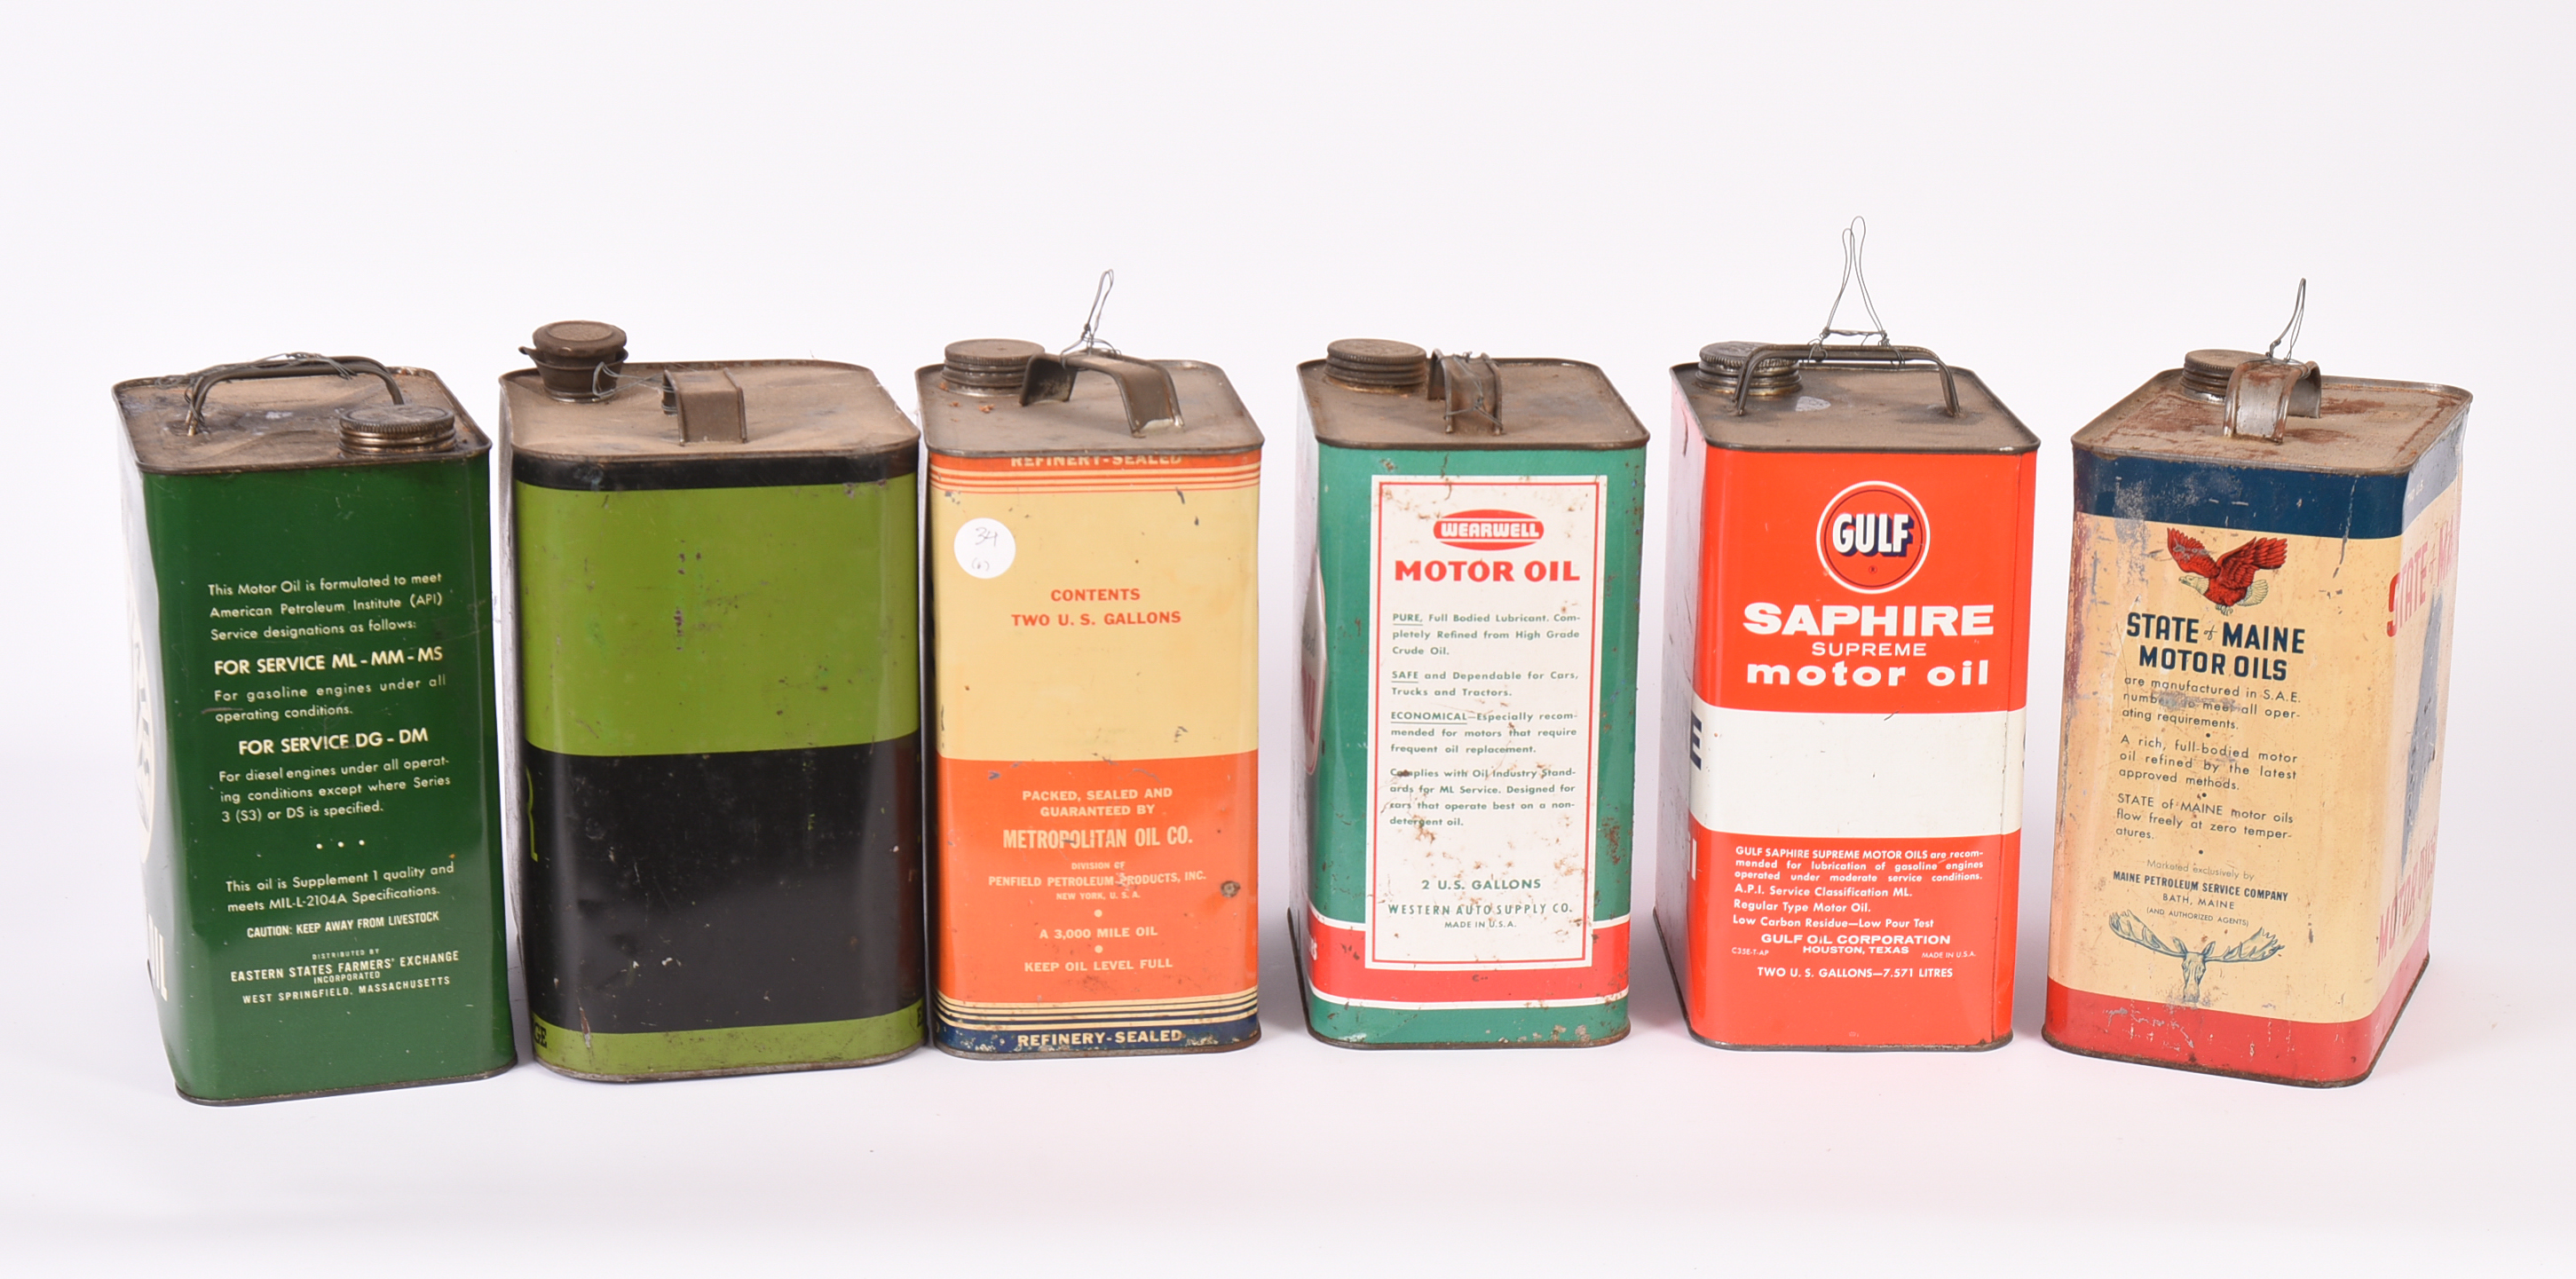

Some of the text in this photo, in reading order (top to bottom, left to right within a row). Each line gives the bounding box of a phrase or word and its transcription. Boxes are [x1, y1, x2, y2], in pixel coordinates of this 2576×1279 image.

[1011, 454, 1181, 466] REFINERY-SEALED
[1441, 523, 1539, 537] WEARWELL
[1832, 513, 1908, 553] GULF
[1395, 559, 1580, 582] MOTOR OIL
[208, 572, 441, 596] This Motor Oil is formulated to meet
[2387, 541, 2428, 637] STATE
[1050, 588, 1140, 601] CONTENTS
[209, 592, 442, 618] American Petroleum Institute (API)
[1011, 613, 1049, 626] TWO
[1103, 611, 1181, 625] GALLONS
[1393, 613, 1422, 622] PURE,
[1453, 613, 1489, 622] Bodied
[1496, 613, 1549, 622] Lubricant.
[1742, 602, 1994, 636] SAPHIRE
[210, 618, 415, 641] Service designations as follows:
[2126, 612, 2305, 654] STATE of MAINE
[1430, 646, 1449, 655] Oil.
[1812, 641, 1926, 656] SUPREME
[2138, 644, 2287, 681] MOTOR OILS
[1747, 659, 1988, 687] motor oil
[2124, 676, 2300, 703] are manufactured in S.A.E.
[238, 738, 274, 755] FOR
[281, 733, 349, 753] SERVICE
[355, 731, 383, 747] DG
[399, 727, 428, 744] DM
[2120, 734, 2297, 762] A rich, full-bodied motor
[1022, 786, 1173, 801] PACKED, SEALED AND
[1039, 803, 1155, 817] GUARANTEED BY
[2117, 793, 2293, 824] STATE of MAINE motor oils
[1003, 825, 1193, 849] METROPOLITAN OIL CO.
[1735, 846, 1762, 856] GULF
[1765, 848, 1809, 858] SAPHIRE
[1812, 849, 1860, 859] SUPREME
[1861, 849, 1901, 859] MOTOR
[1904, 849, 1928, 859] OILS
[2146, 858, 2255, 881] Marketed exclusively by
[988, 875, 1041, 887] PENFIELD
[1047, 875, 1113, 887] PETROLEUM
[1184, 870, 1205, 880] INC.
[1421, 880, 1429, 889] 2
[1471, 879, 1540, 890] GALLONS
[2113, 870, 2288, 901] MAINE PETROLEUM SERVICE COMPANY
[227, 886, 439, 912] meets MIL-L-2104A Specifications.
[1734, 898, 1870, 913] Regular Type Motor Oil.
[2162, 893, 2234, 910] BATH, MAINE
[1387, 903, 1572, 915] WESTERN AUTO SUPPLY CO.
[2146, 906, 2248, 927] (AND AUTHORIZED AGENTS)
[247, 911, 439, 938] CAUTION: KEEP AWAY FROM LIVESTOCK
[1039, 926, 1158, 940] A 3,000 MILE OIL
[1761, 933, 1950, 944] GULF OIL CORPORATION
[312, 949, 365, 960] DISTRIBUTED
[1803, 945, 1865, 954] HOUSTON,
[230, 967, 284, 982] EASTERN
[288, 963, 332, 977] STATES
[399, 950, 458, 967] EXCHANGE
[1023, 958, 1173, 972] KEEP OIL LEVEL FULL
[1757, 967, 1786, 976] TWO
[1918, 967, 1953, 977] LITRES
[313, 970, 380, 983] INCORPORATED
[242, 993, 272, 1004] WEST
[358, 975, 450, 993] MASSACHUSETTS
[1017, 1030, 1182, 1046] REFINERY-SEALED
